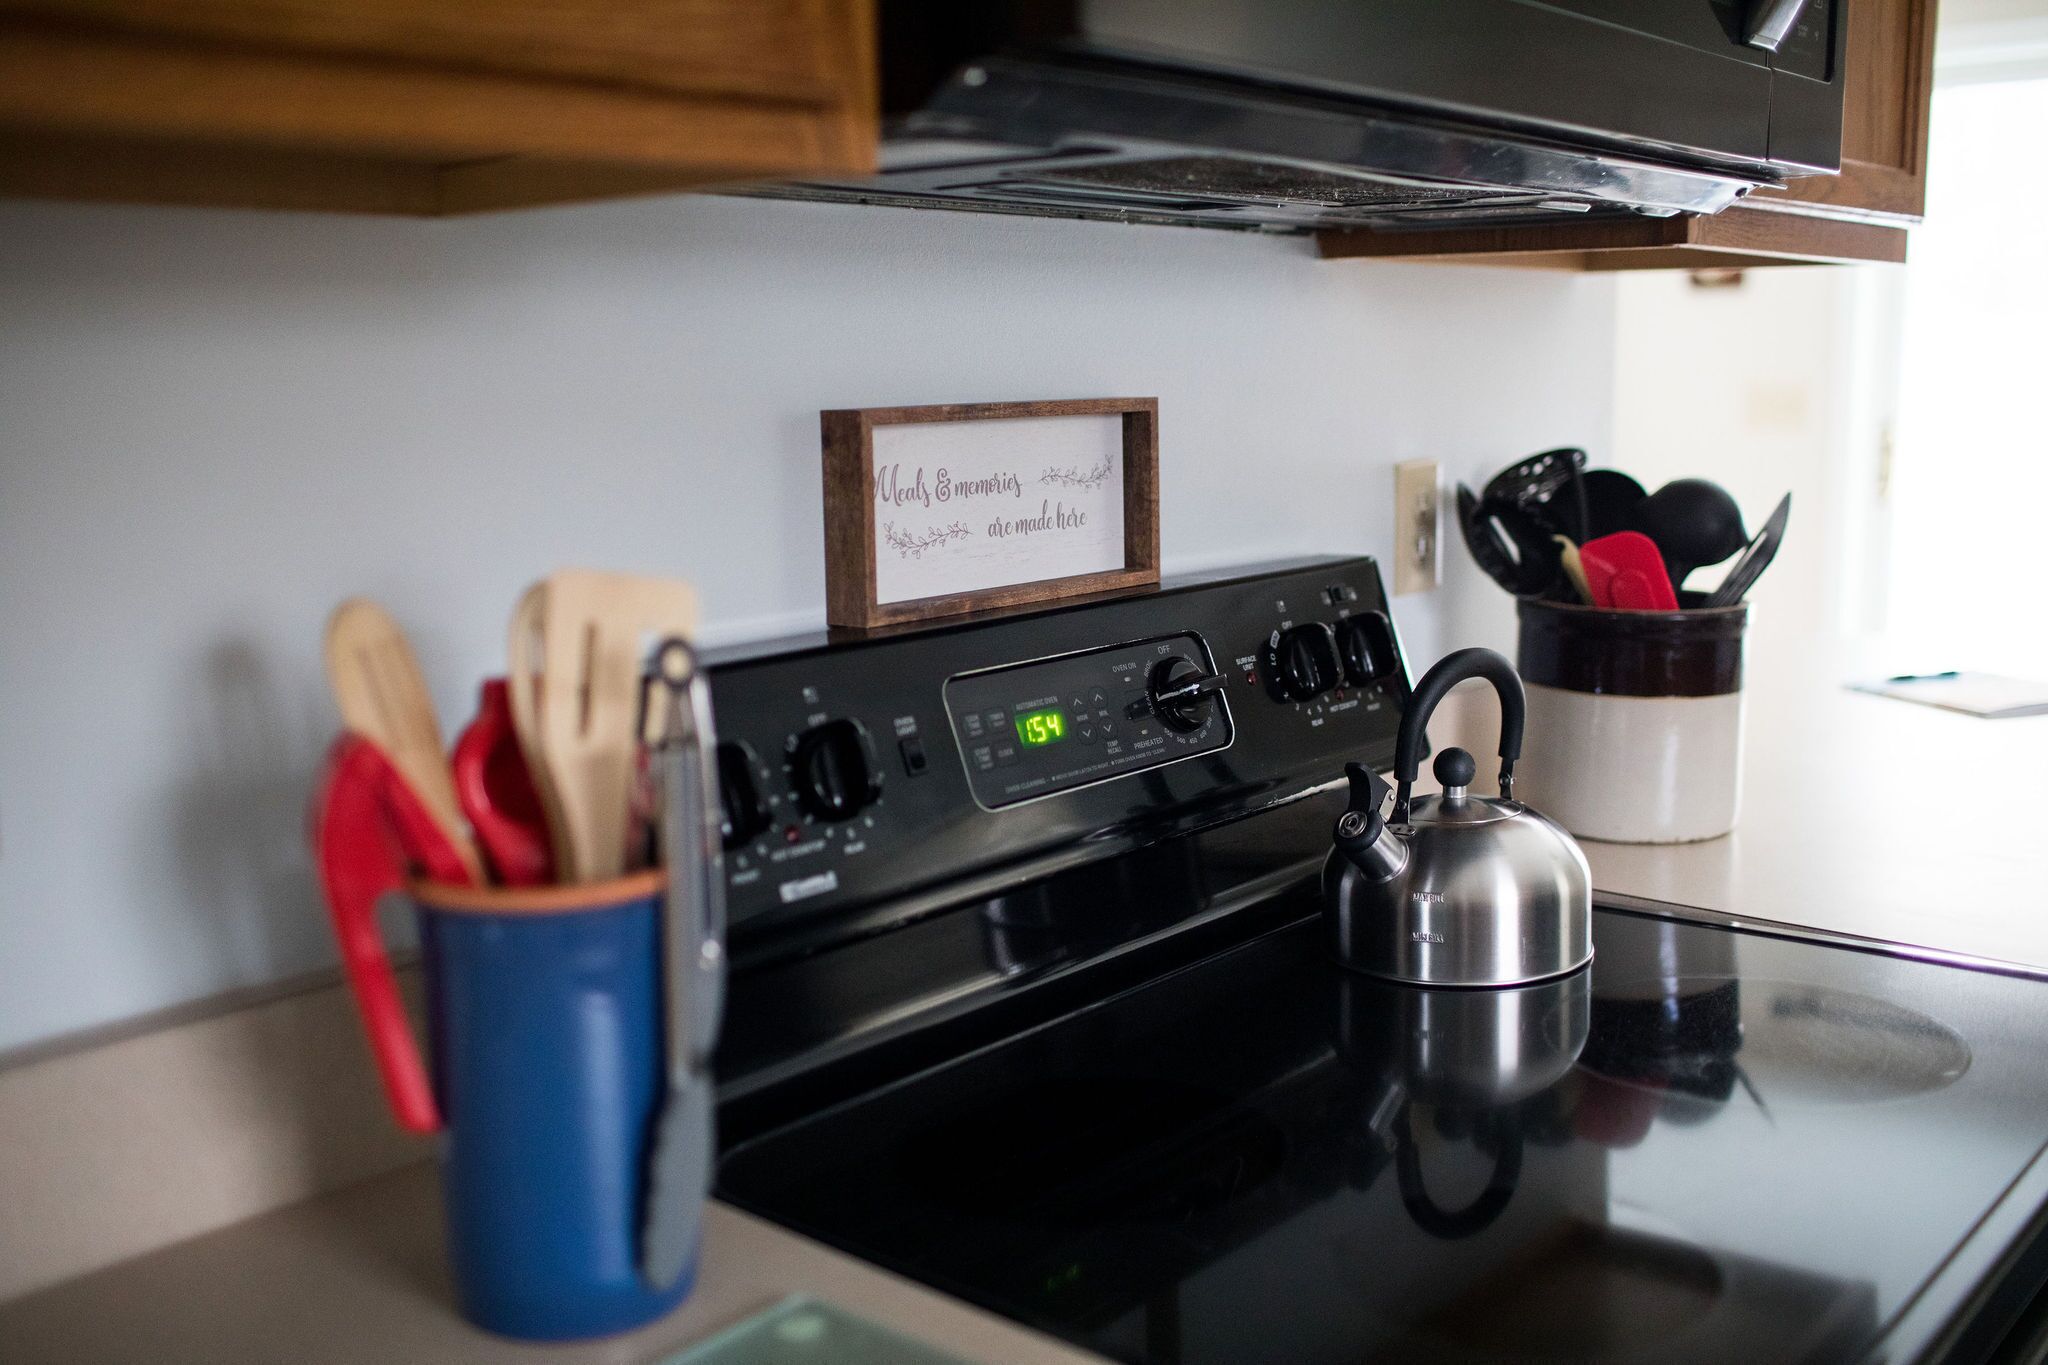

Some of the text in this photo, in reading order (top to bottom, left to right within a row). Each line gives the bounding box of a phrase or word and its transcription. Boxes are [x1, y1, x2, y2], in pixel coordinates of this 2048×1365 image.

[874, 464, 1023, 508] Meals & memories
[988, 499, 1087, 538] are made here
[1157, 645, 1171, 655] OFF
[1112, 662, 1137, 673] OVEN ON
[1133, 737, 1164, 750] PREHEATED
